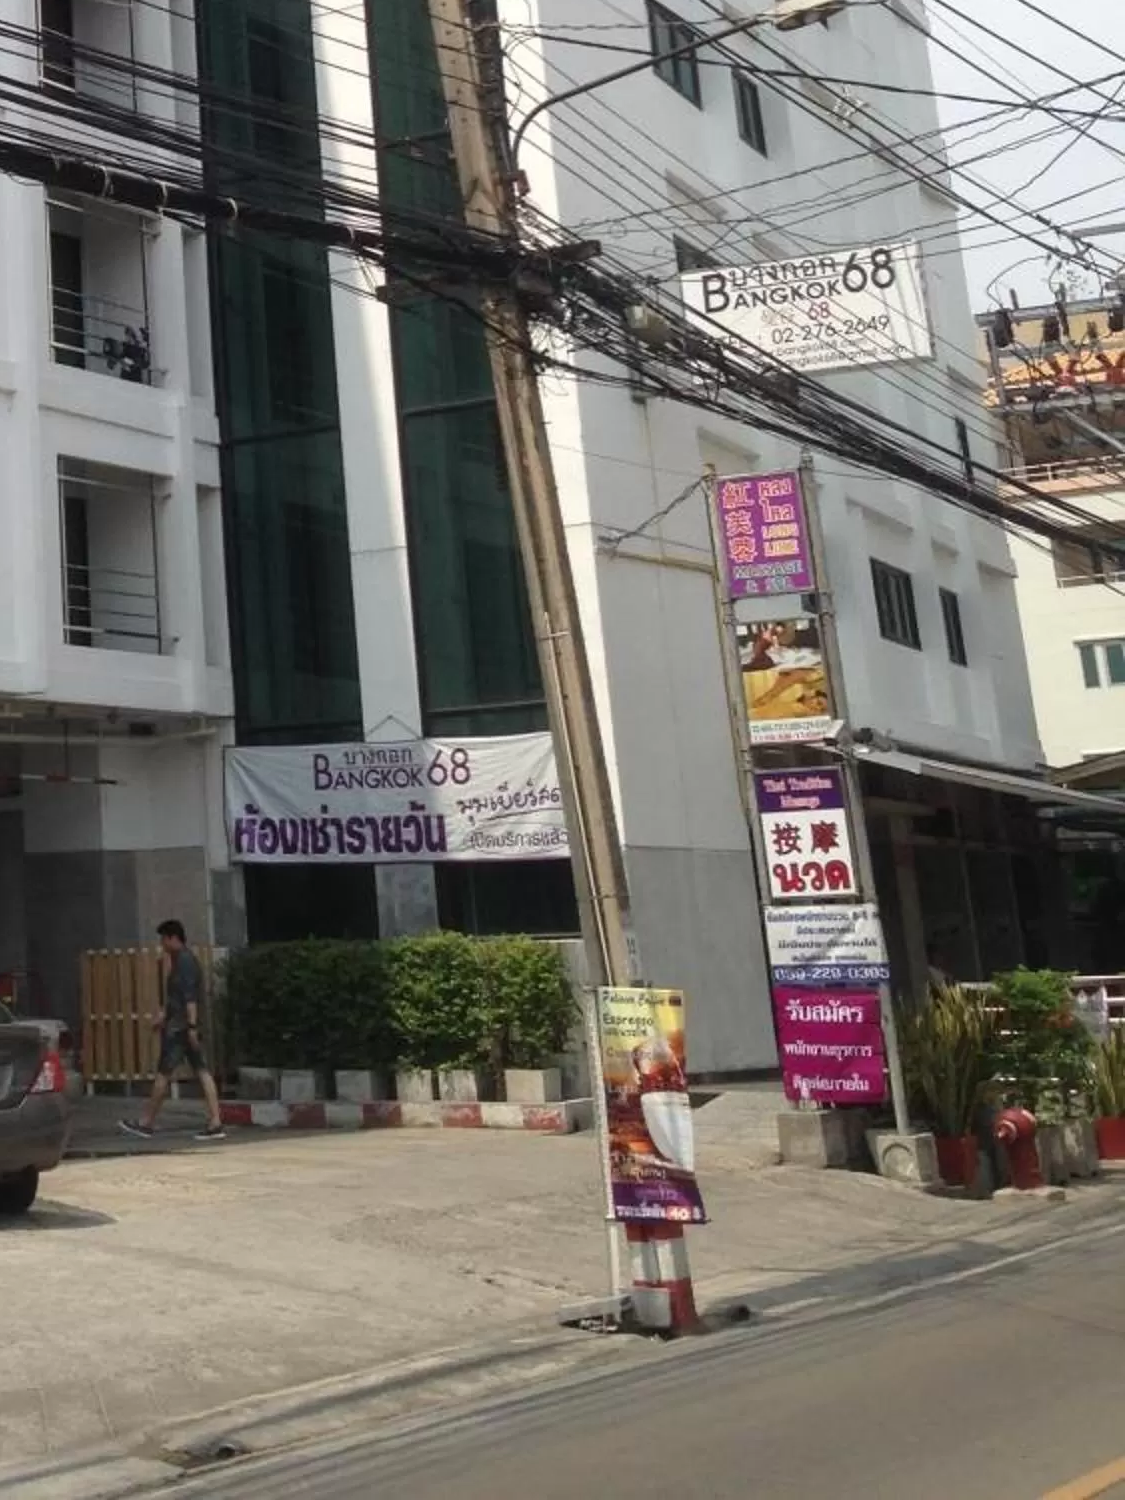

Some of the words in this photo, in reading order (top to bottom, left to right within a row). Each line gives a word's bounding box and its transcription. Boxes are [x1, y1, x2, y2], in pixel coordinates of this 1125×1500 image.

[702, 270, 842, 314] BANGKOK
[842, 249, 896, 293] 68
[313, 753, 424, 790] BANGKOK
[427, 747, 471, 786] 68
[234, 801, 449, 855] ห้องเช่ารายวัน
[773, 860, 851, 892] นวด
[785, 999, 864, 1023] รับสมัคร
